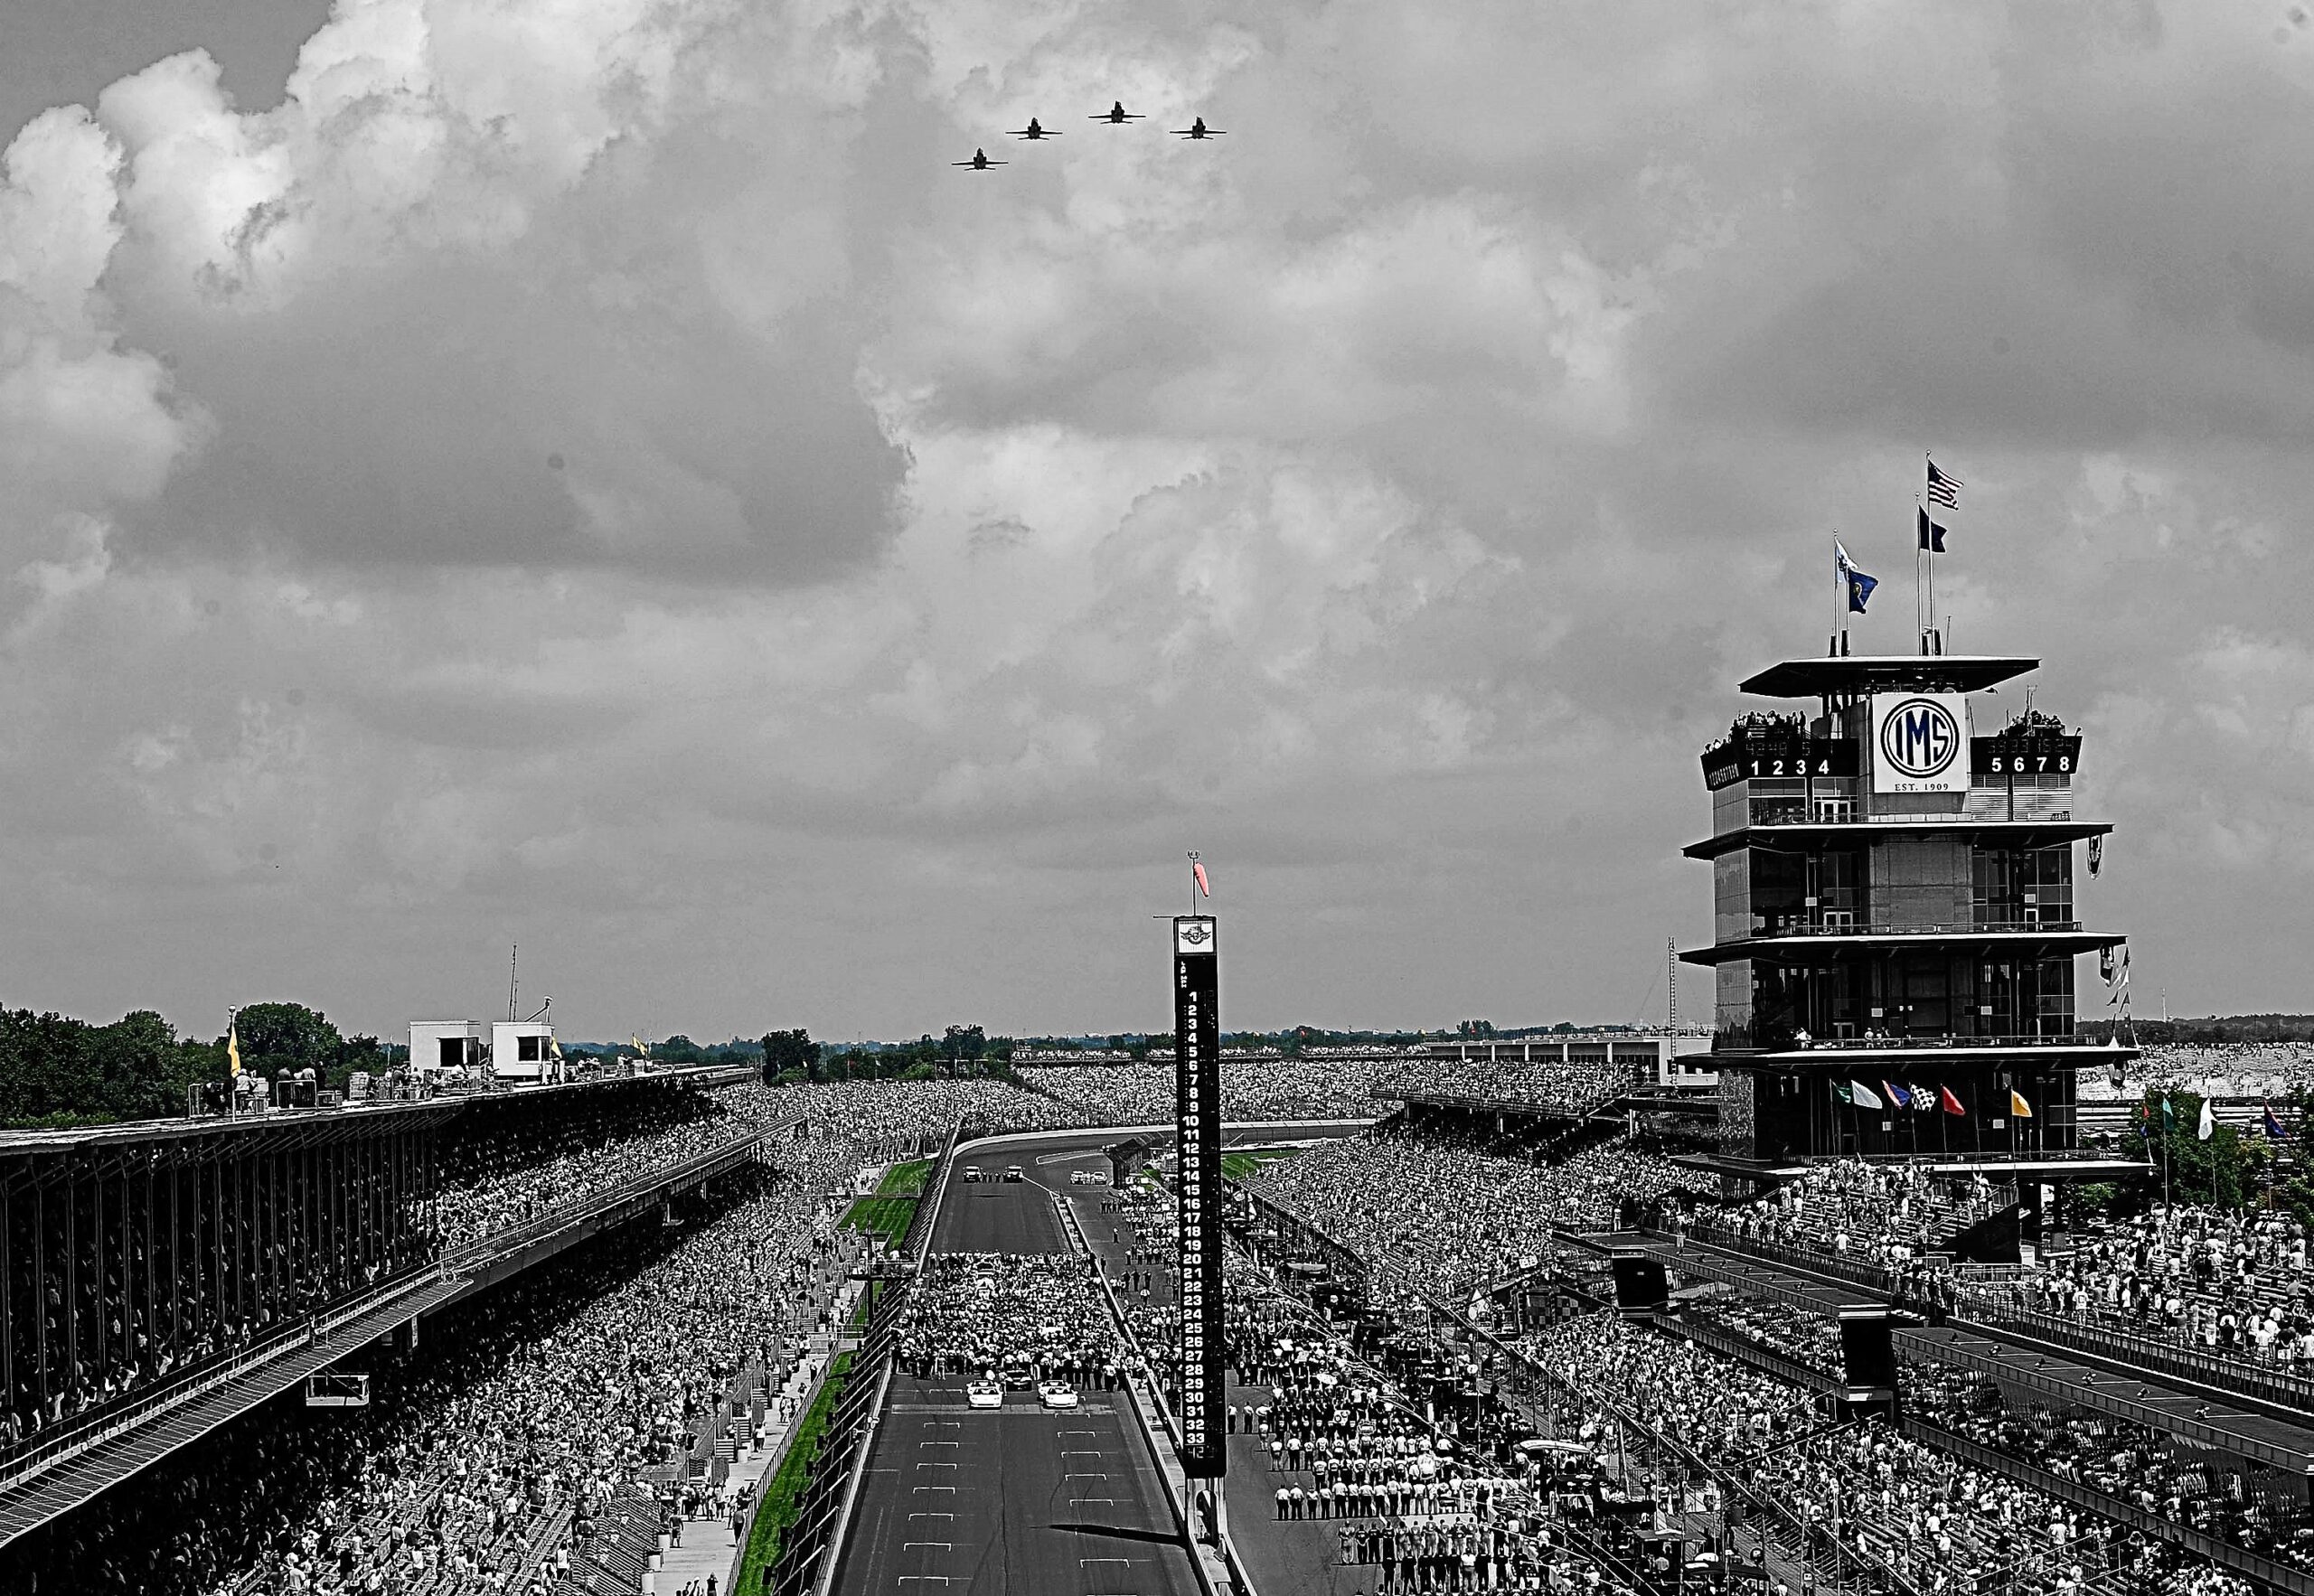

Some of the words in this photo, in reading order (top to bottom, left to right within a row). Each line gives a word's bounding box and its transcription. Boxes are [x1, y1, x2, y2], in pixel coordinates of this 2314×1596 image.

[1895, 709, 1949, 767] IMS
[1751, 760, 1759, 775] 1
[1773, 760, 1783, 775] 2
[1796, 759, 1806, 775] 3
[1818, 759, 1830, 775] 4
[1991, 757, 2002, 772] 5
[2014, 756, 2025, 772] 6
[2037, 756, 2047, 772] 7
[2059, 756, 2069, 771] 8
[1895, 783, 1918, 792] EST.
[1924, 783, 1949, 791] 1909
[1189, 991, 1197, 1001] 1
[1188, 1005, 1197, 1016] 2
[1188, 1019, 1197, 1029] 3
[1187, 1033, 1197, 1043] 4
[1189, 1047, 1197, 1056] 5
[1189, 1061, 1198, 1071] 6
[1189, 1075, 1198, 1084] 7
[1189, 1087, 1198, 1099] 8
[1189, 1102, 1198, 1112] 9
[1182, 1115, 1199, 1126] 10
[1184, 1130, 1199, 1140] 11
[1183, 1143, 1199, 1153] 12
[1183, 1157, 1199, 1168] 13
[1183, 1171, 1199, 1181] 14
[1183, 1185, 1199, 1195] 15
[1184, 1198, 1200, 1209] 16
[1184, 1213, 1200, 1223] 17
[1184, 1226, 1200, 1236] 18
[1185, 1240, 1201, 1251] 19
[1183, 1253, 1201, 1264] 20
[1184, 1268, 1201, 1278] 21
[1184, 1281, 1201, 1292] 22
[1184, 1295, 1202, 1306] 23
[1184, 1309, 1202, 1319] 24
[1185, 1323, 1202, 1333] 25
[1185, 1337, 1202, 1347] 26
[1186, 1350, 1203, 1361] 27
[1185, 1365, 1203, 1375] 28
[1185, 1378, 1203, 1389] 29
[1186, 1392, 1203, 1403] 30
[1187, 1405, 1204, 1416] 31
[1186, 1419, 1204, 1430] 32
[1187, 1433, 1204, 1443] 33
